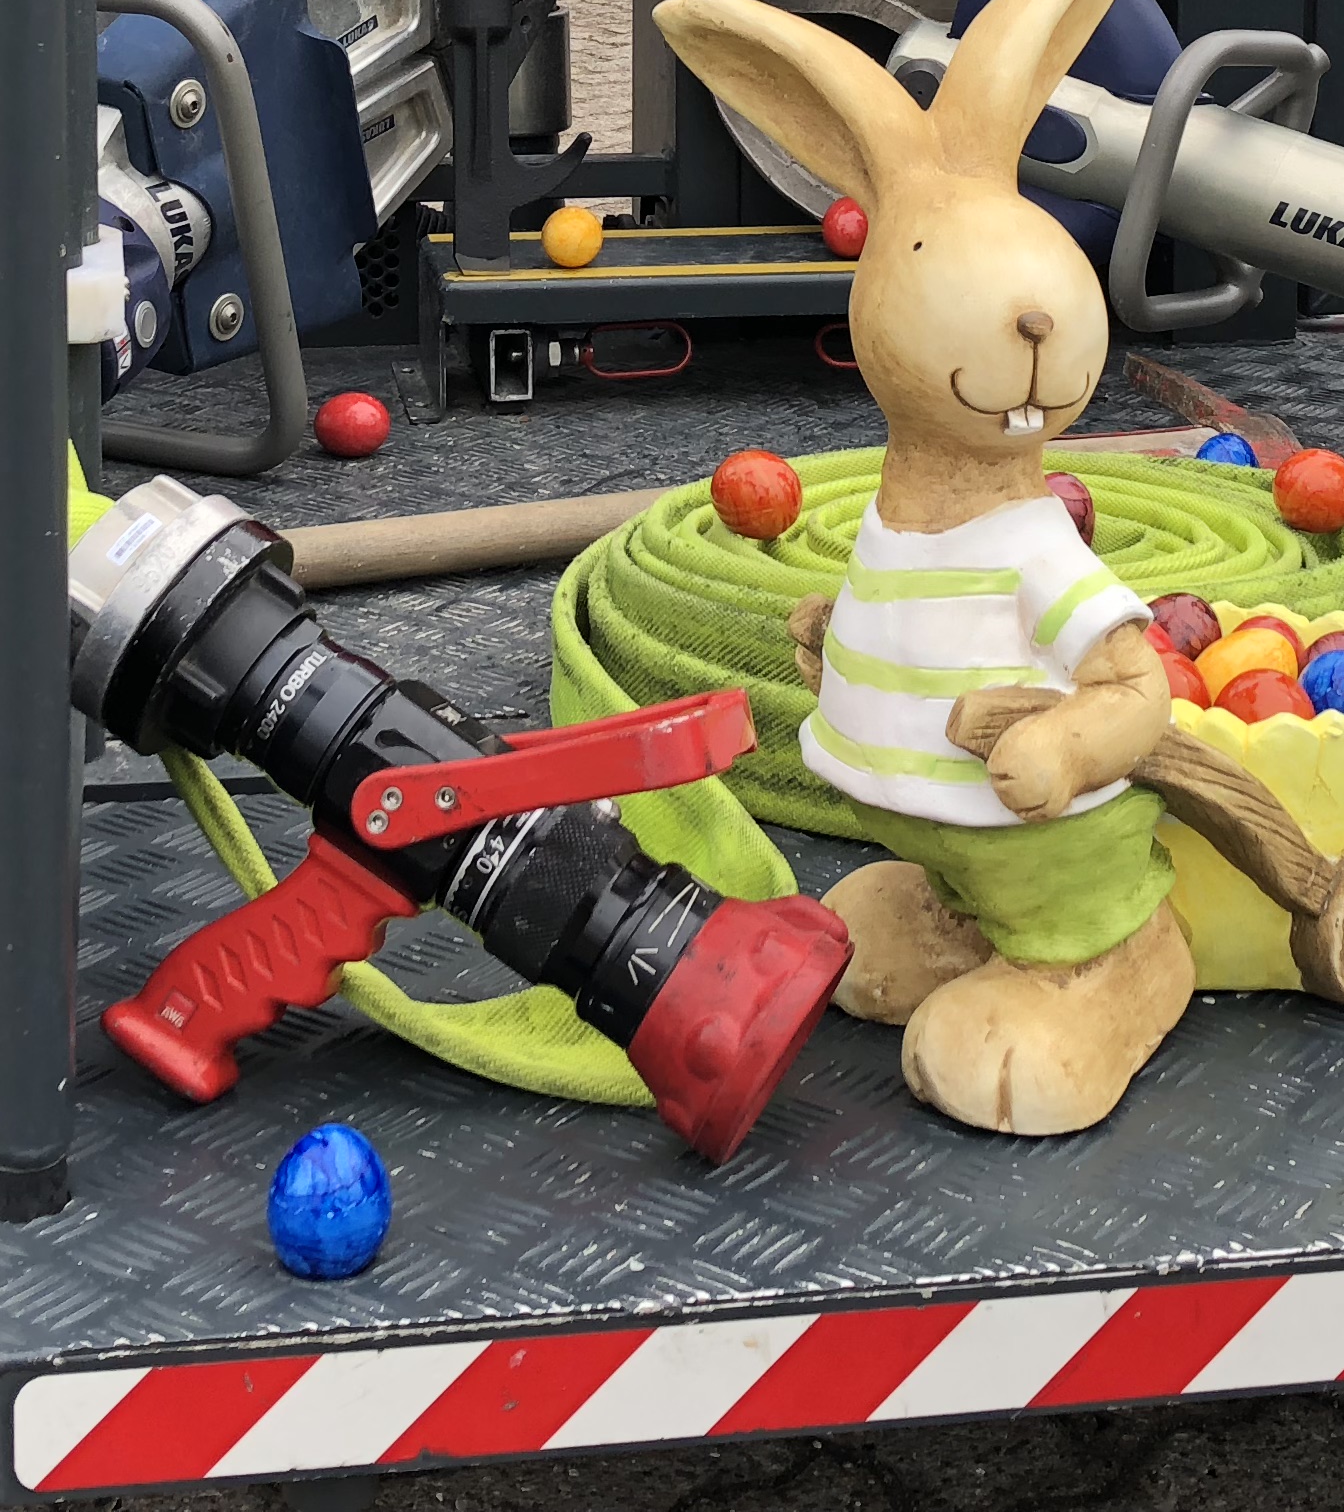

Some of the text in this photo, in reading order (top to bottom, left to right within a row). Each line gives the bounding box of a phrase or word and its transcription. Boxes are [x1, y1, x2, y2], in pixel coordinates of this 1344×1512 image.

[342, 19, 376, 46] LUKAS
[257, 651, 327, 740] TURBO 2400
[160, 1005, 185, 1028] AWG
